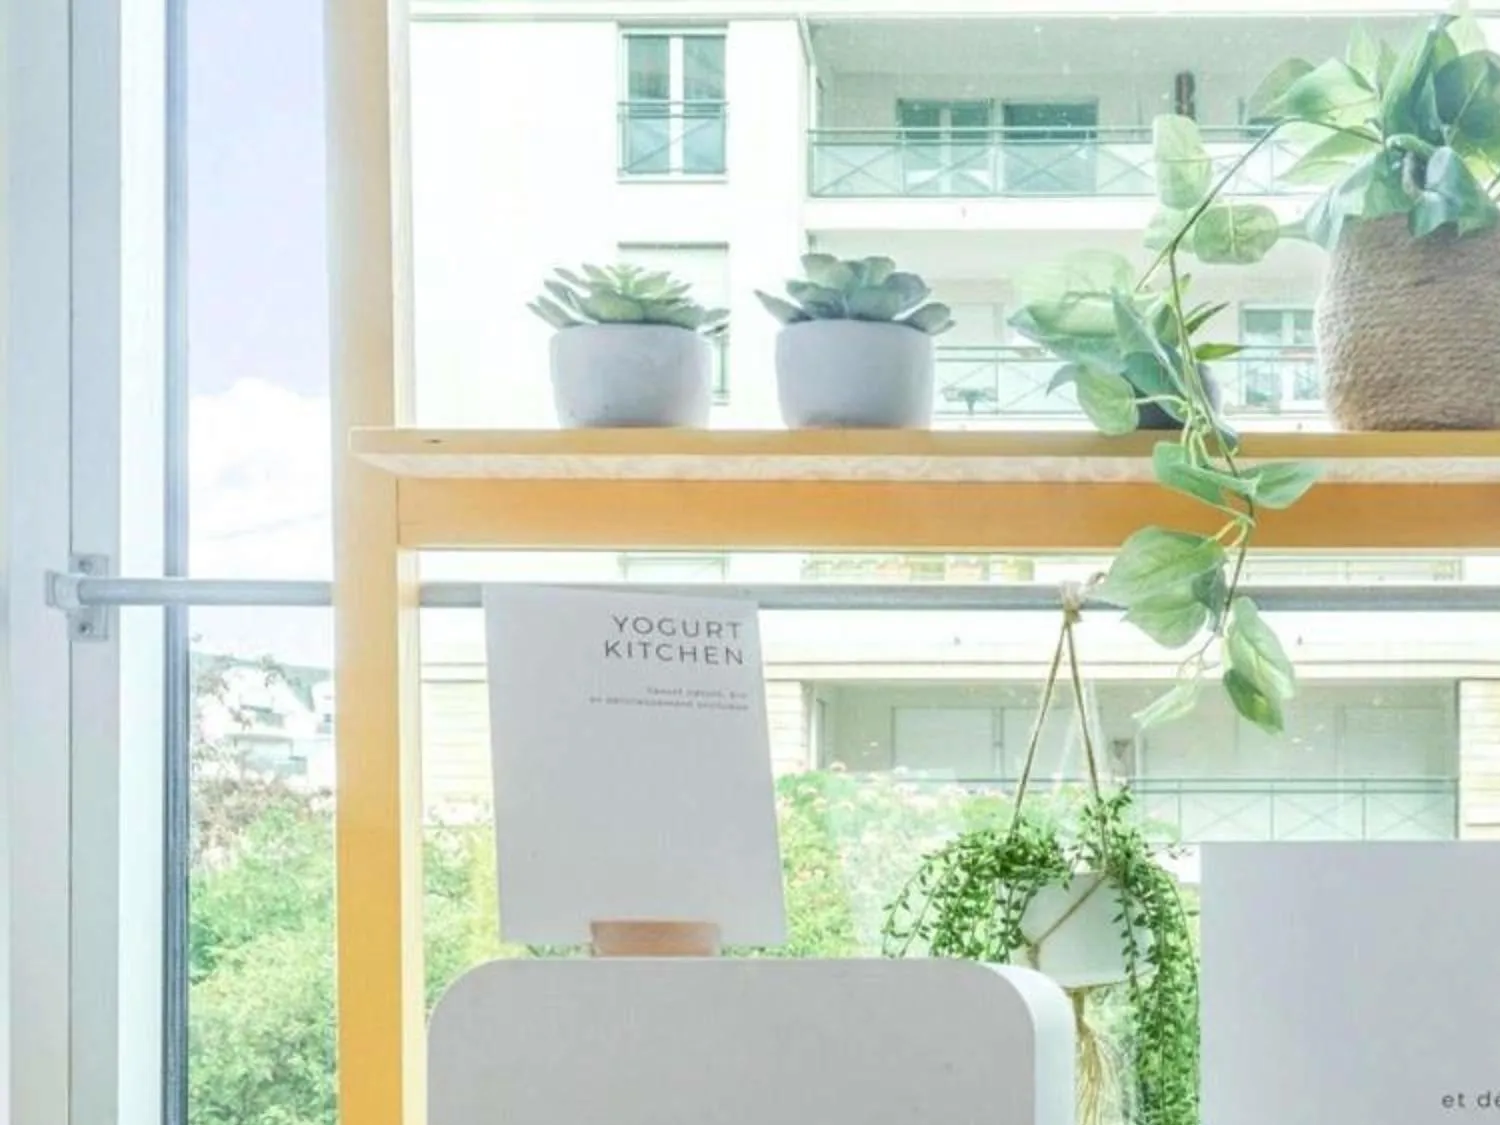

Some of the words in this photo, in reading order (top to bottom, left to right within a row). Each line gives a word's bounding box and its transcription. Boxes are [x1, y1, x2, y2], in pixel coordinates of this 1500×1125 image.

[612, 615, 742, 640] YOGURT
[604, 639, 744, 666] KITCHEN
[1441, 1091, 1466, 1110] et
